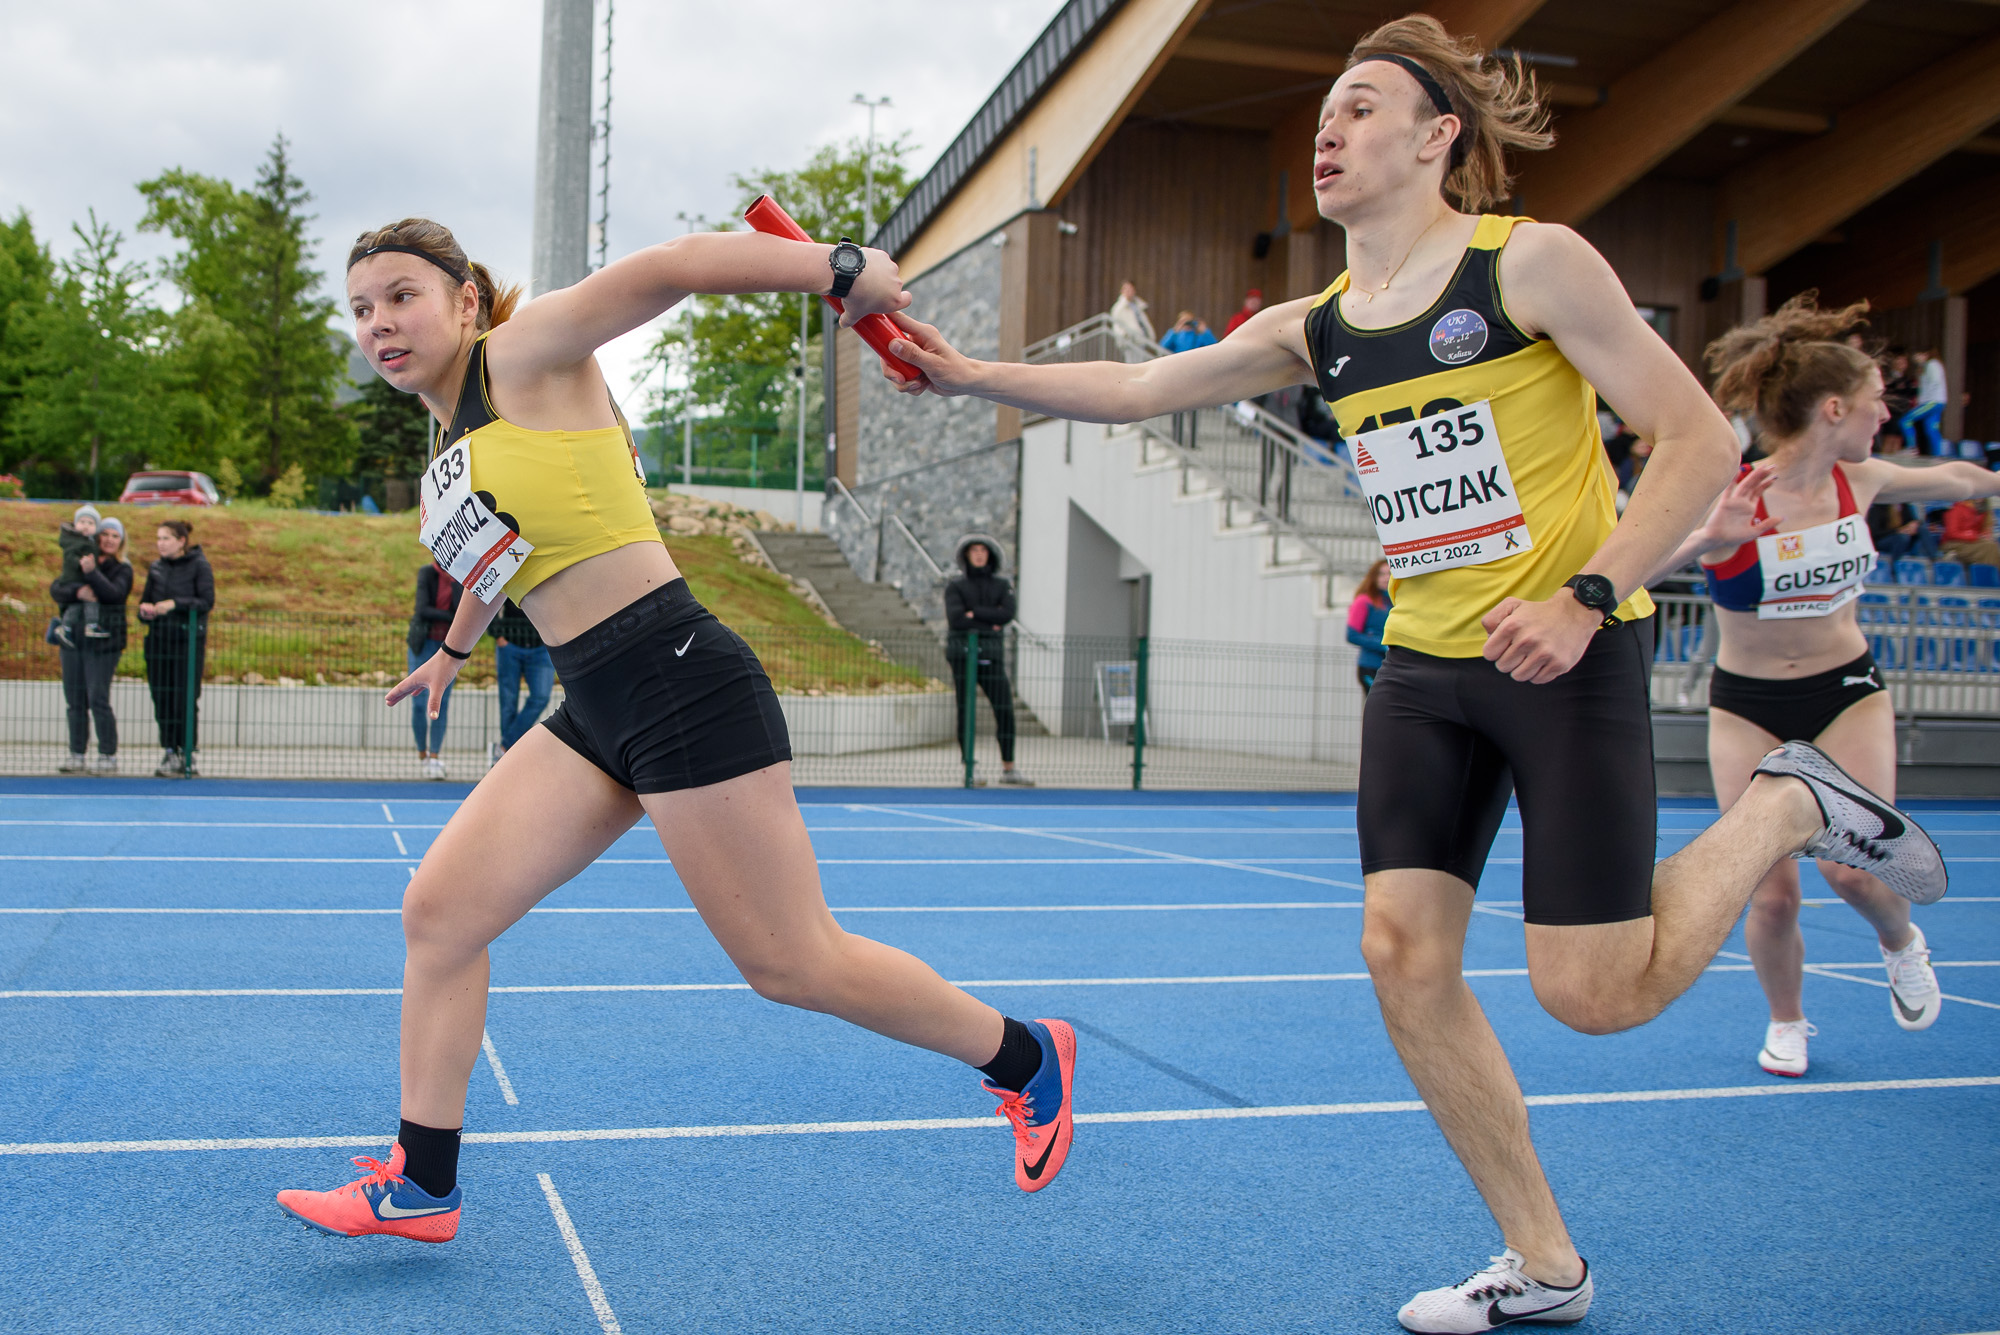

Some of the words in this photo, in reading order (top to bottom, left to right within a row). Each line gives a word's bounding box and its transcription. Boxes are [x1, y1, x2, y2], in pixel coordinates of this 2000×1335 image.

[1408, 411, 1484, 460] 135
[431, 448, 465, 500] 133
[430, 497, 490, 571] OŹDZIEWICZ
[1388, 551, 1441, 569] ARPACZ
[1444, 543, 1482, 560] 2022
